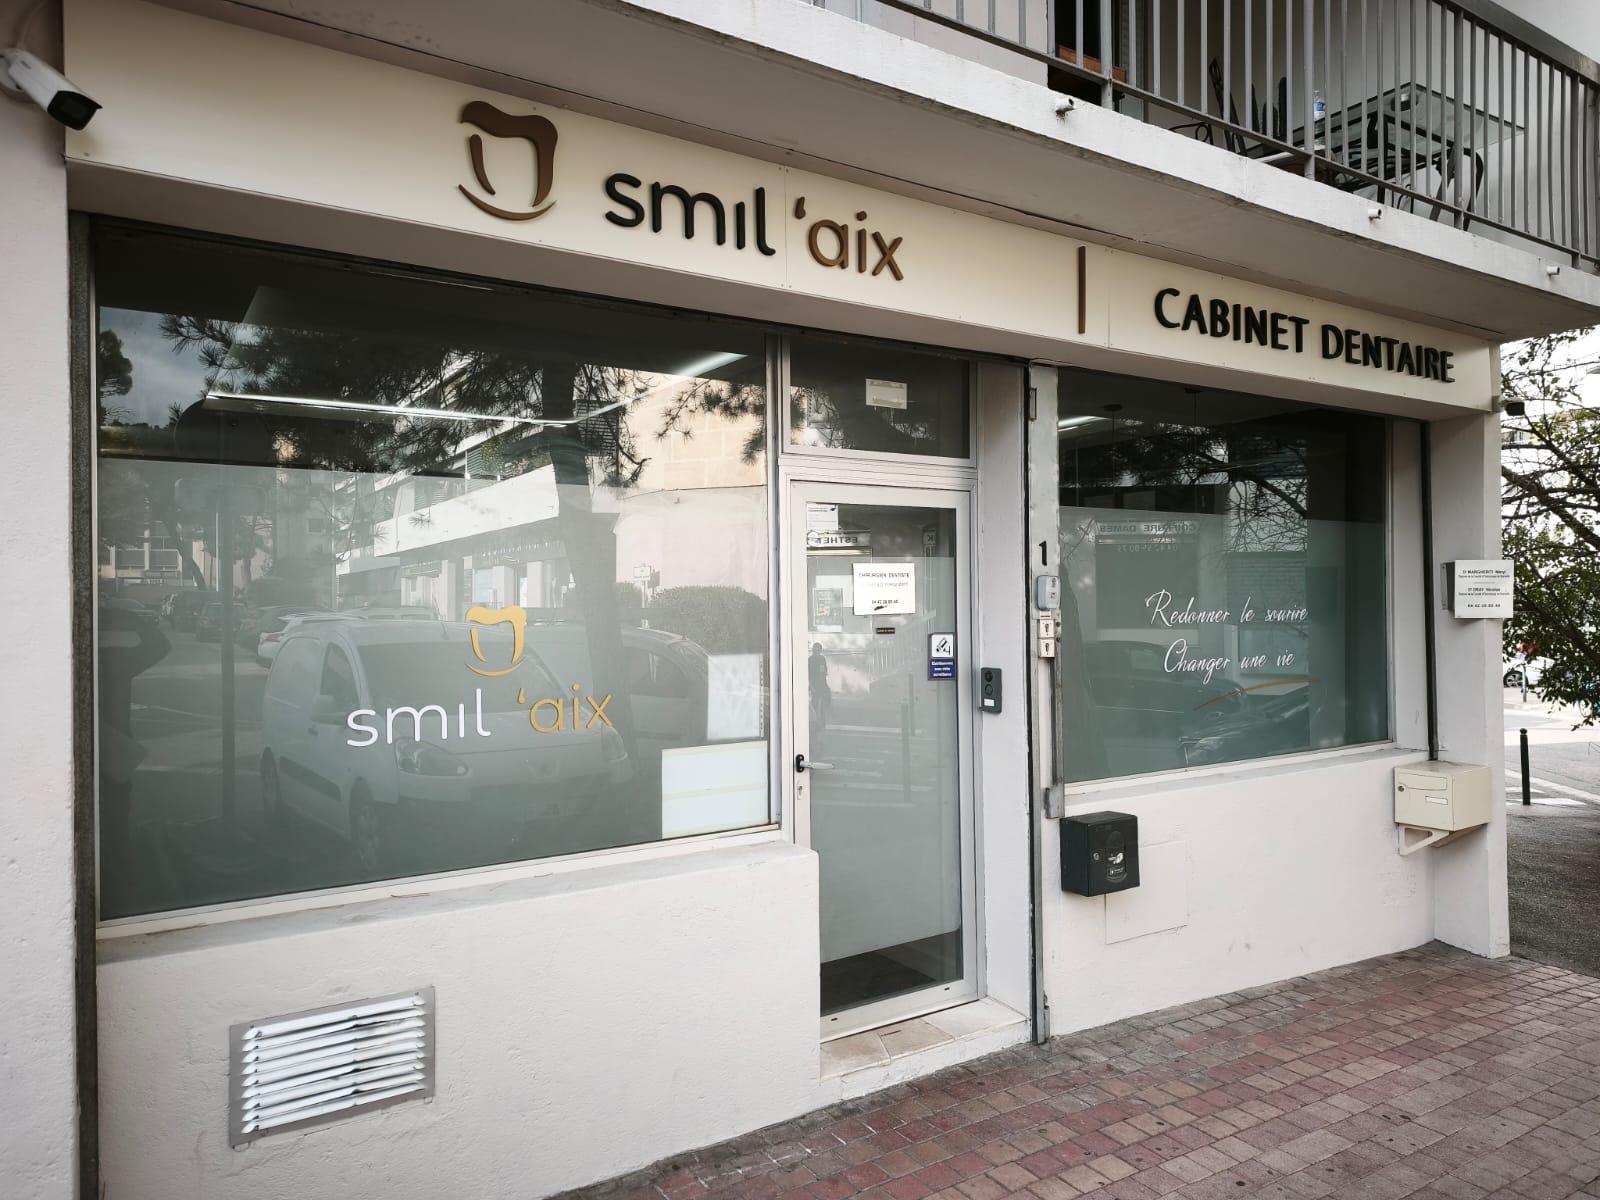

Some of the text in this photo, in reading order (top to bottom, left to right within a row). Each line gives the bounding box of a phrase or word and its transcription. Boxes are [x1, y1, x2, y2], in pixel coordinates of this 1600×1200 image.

[1154, 287, 1456, 383] CABINET DENTAIRE
[1038, 540, 1048, 566] 1
[1145, 589, 1309, 628] Redonner le sourire
[1163, 638, 1295, 685] Changer une vie
